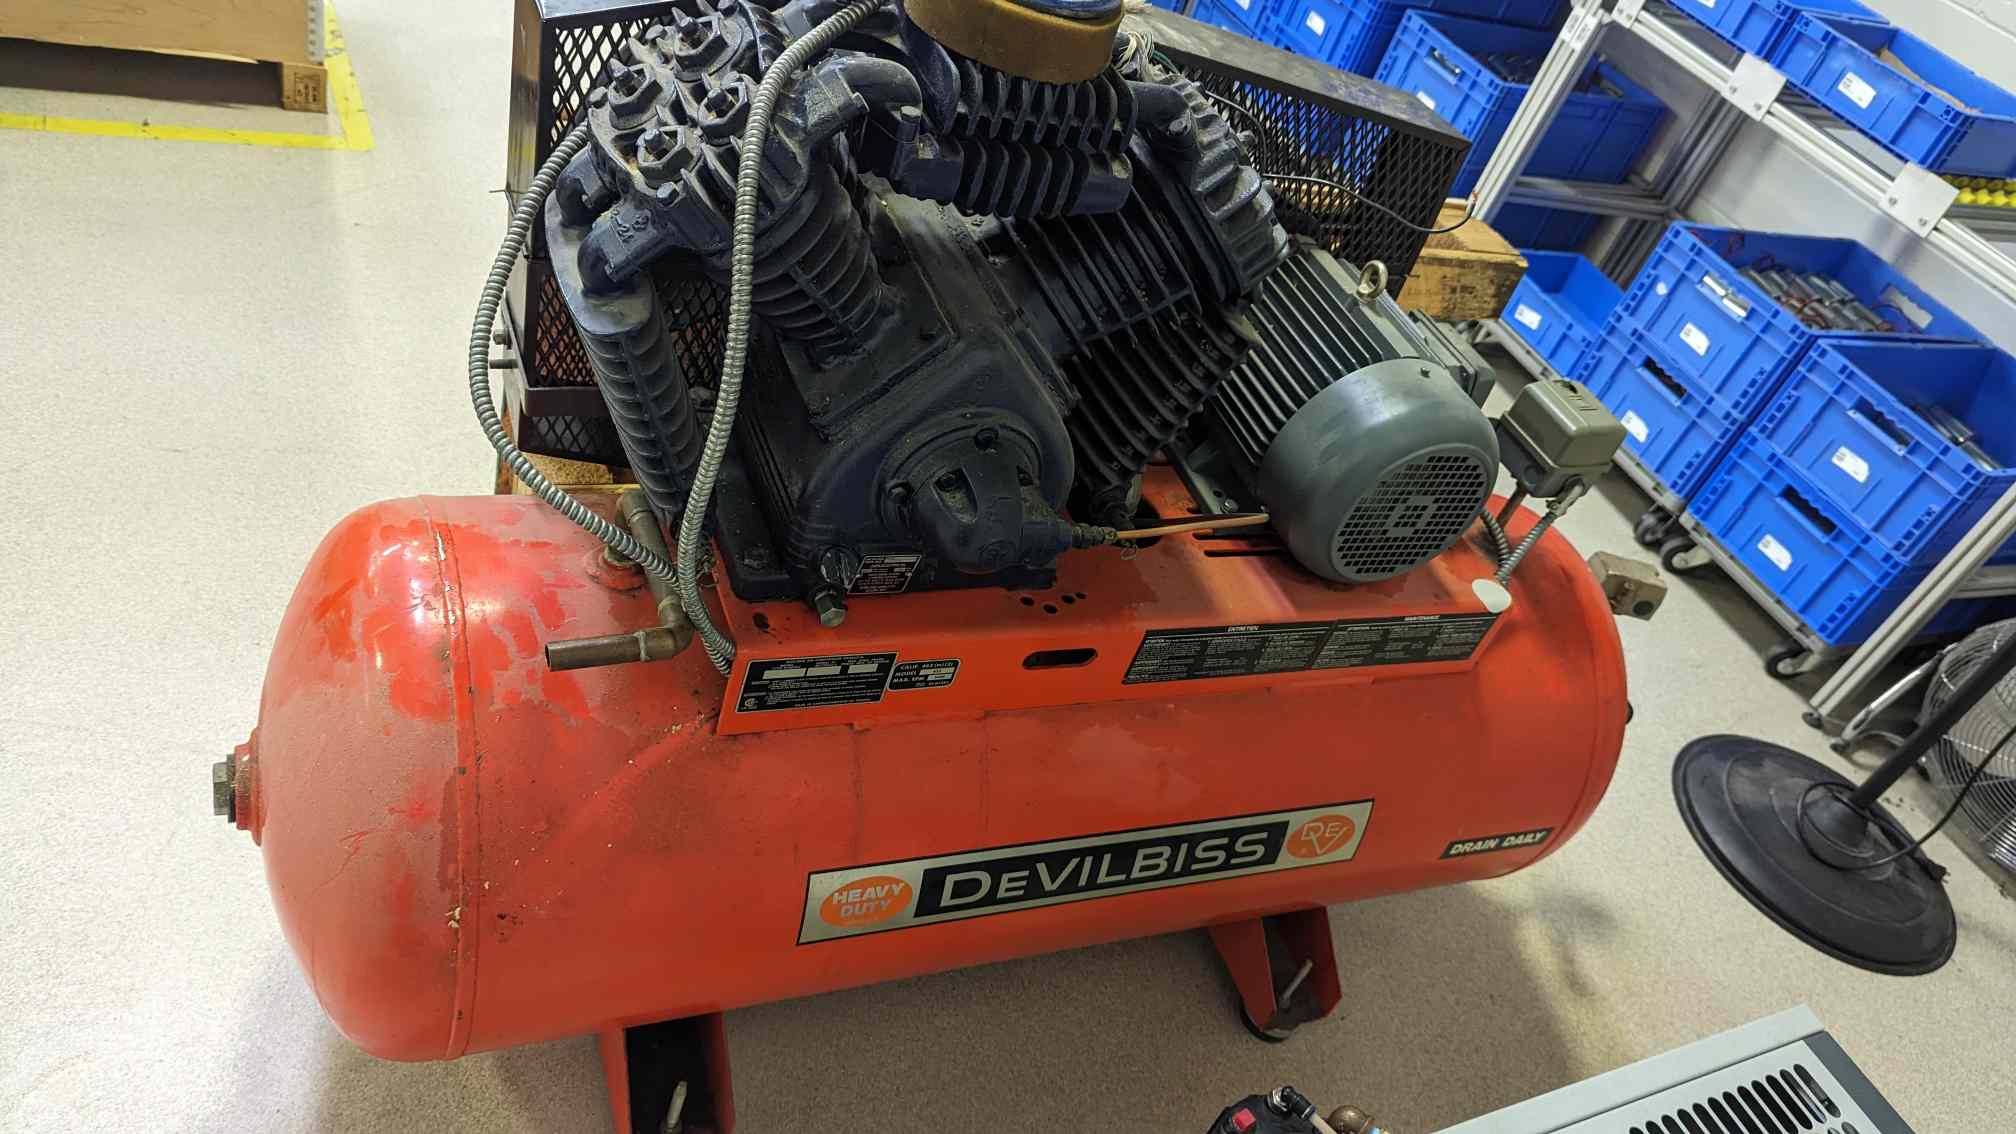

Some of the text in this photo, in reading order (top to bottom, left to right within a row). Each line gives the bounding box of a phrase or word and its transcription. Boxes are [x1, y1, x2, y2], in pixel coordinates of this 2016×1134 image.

[1448, 830, 1549, 856] DRAIN DAILY
[832, 882, 906, 905] HEAVY
[840, 898, 894, 918] DUTY
